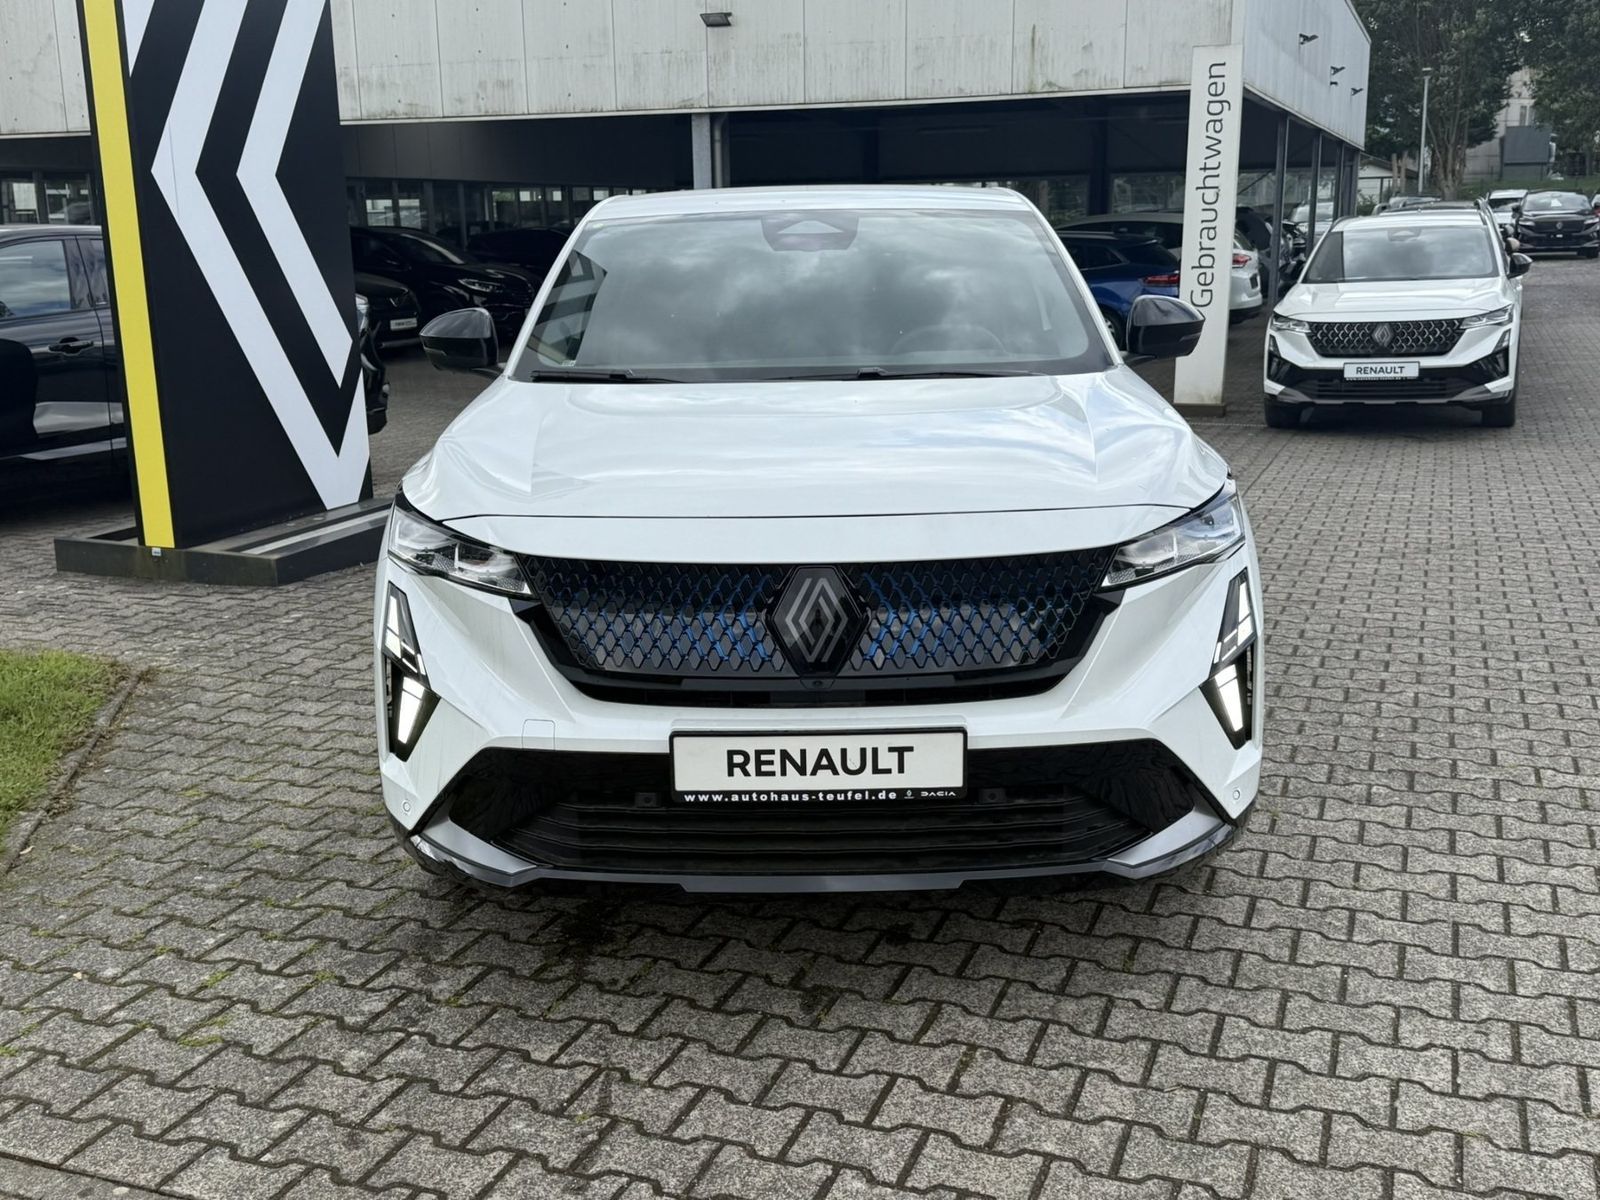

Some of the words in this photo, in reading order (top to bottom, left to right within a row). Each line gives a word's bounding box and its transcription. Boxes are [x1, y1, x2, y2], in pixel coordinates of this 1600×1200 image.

[1190, 61, 1231, 307] Gebrauchtwagen
[1356, 366, 1405, 375] RENAULT
[726, 746, 914, 777] RENAULT
[684, 790, 897, 802] www.autohaus-teufel.de
